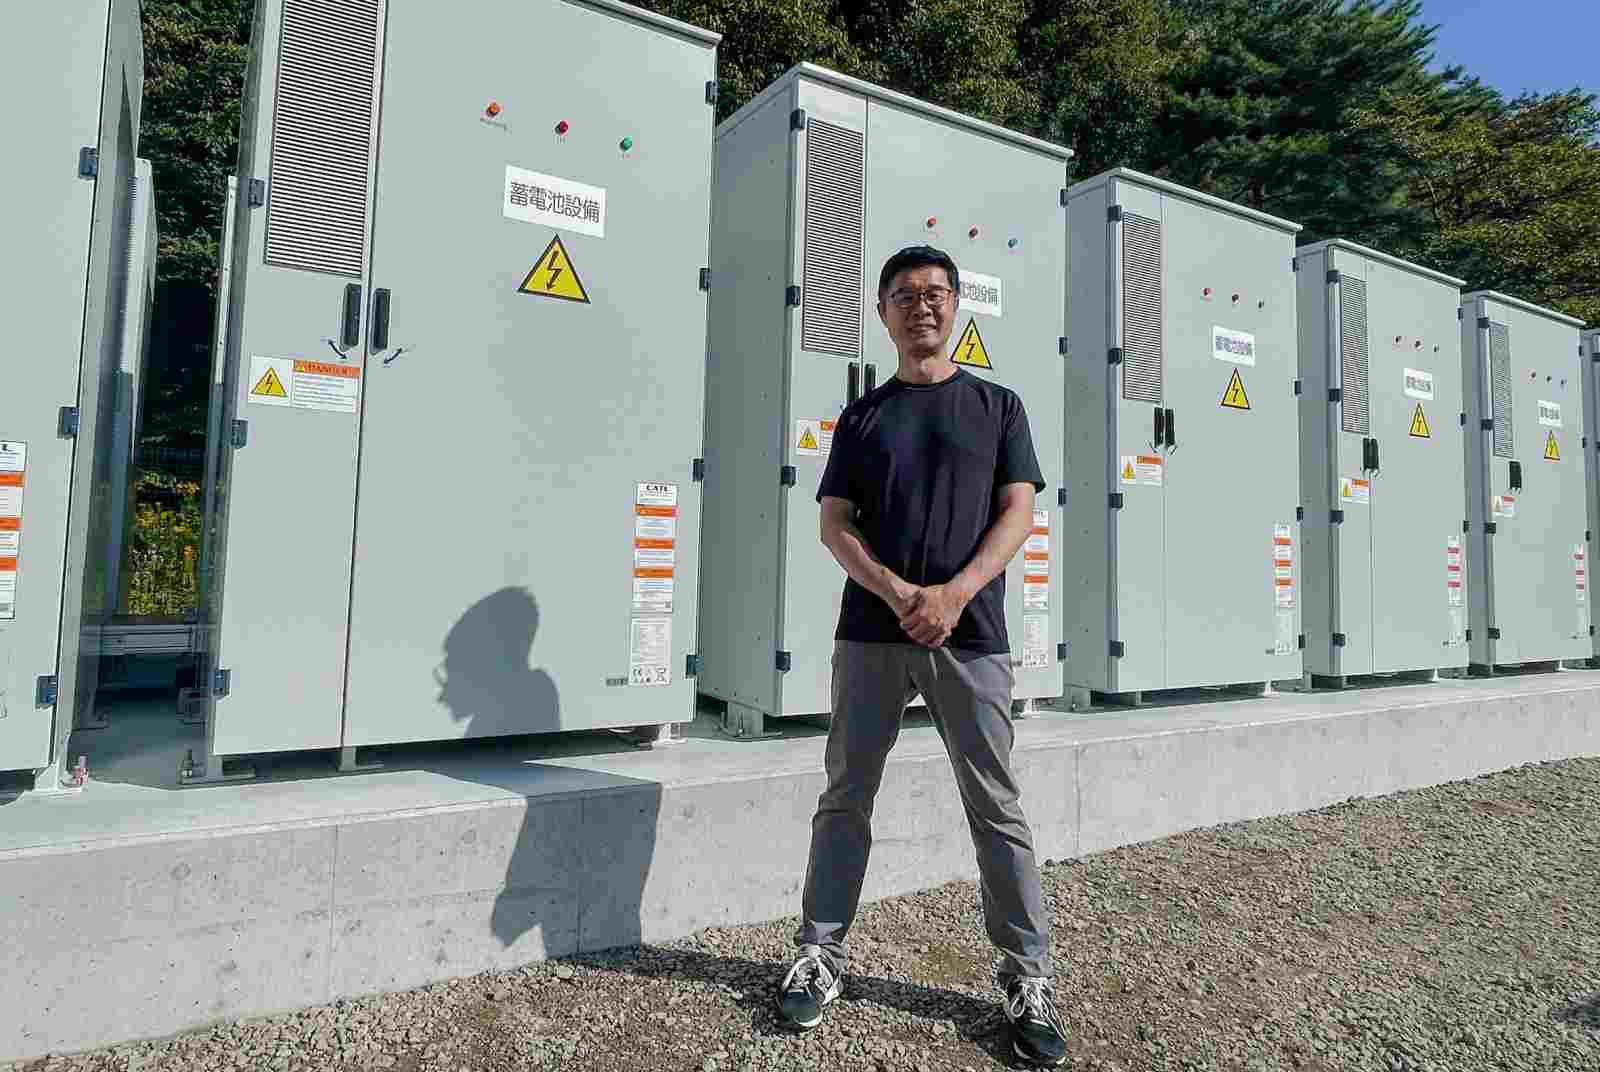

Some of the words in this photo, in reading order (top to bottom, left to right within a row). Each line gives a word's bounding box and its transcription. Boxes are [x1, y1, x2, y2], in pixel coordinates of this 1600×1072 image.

[510, 181, 600, 224] 蓄電池設備
